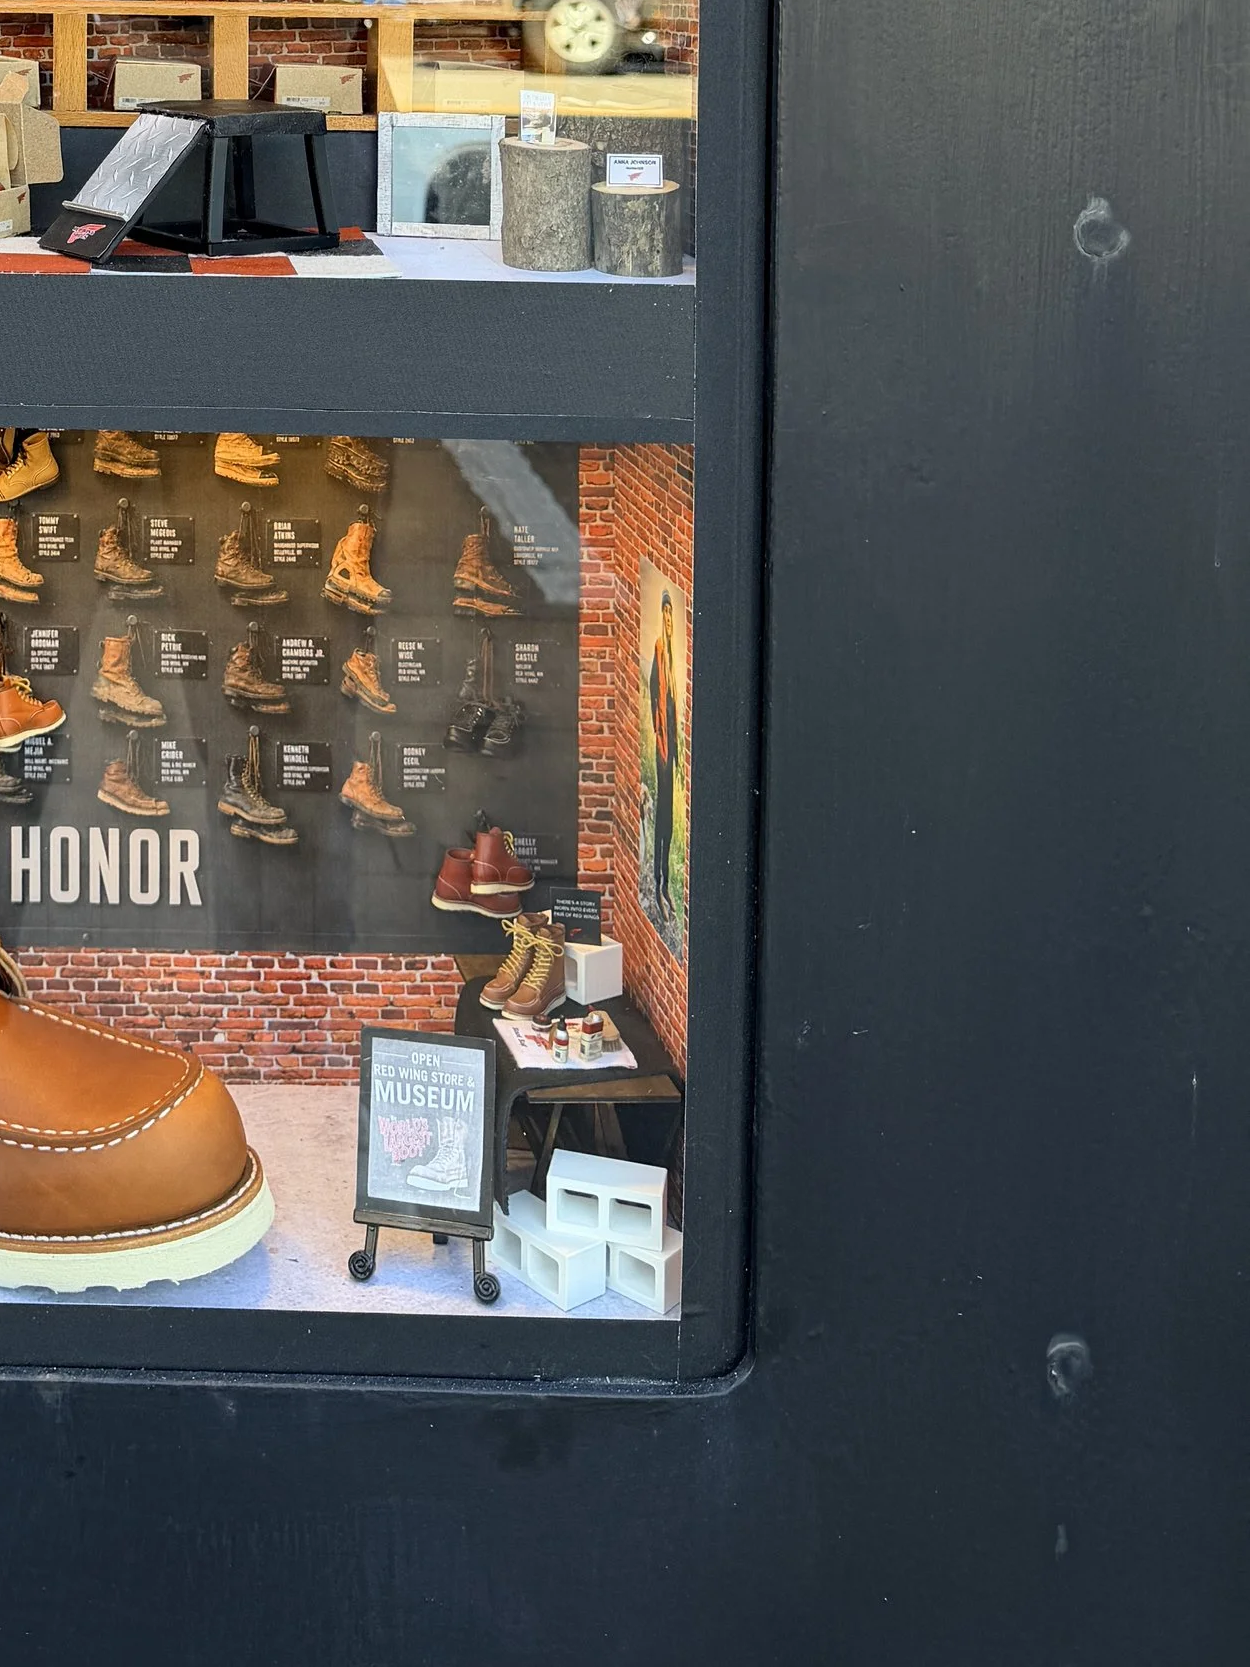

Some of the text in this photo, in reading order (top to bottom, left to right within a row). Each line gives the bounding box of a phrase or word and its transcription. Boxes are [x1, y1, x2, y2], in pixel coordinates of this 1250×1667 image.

[38, 516, 60, 525] TOMMY
[150, 519, 168, 528] STEVE
[38, 525, 57, 534] SWIFT
[30, 629, 59, 639] JENNIFER
[281, 638, 308, 648] ANDREW
[398, 641, 416, 651] REESE
[514, 643, 540, 653] SHARON
[281, 648, 314, 657] CHAMBERS
[514, 653, 538, 662] CASTLE
[161, 740, 177, 750] MIKE
[283, 744, 310, 754] KENNETH
[10, 824, 203, 906] HONOR
[412, 1052, 441, 1068] OPEN
[374, 1063, 475, 1088] RED WING STORE &
[374, 1079, 475, 1113] MUSEUM
